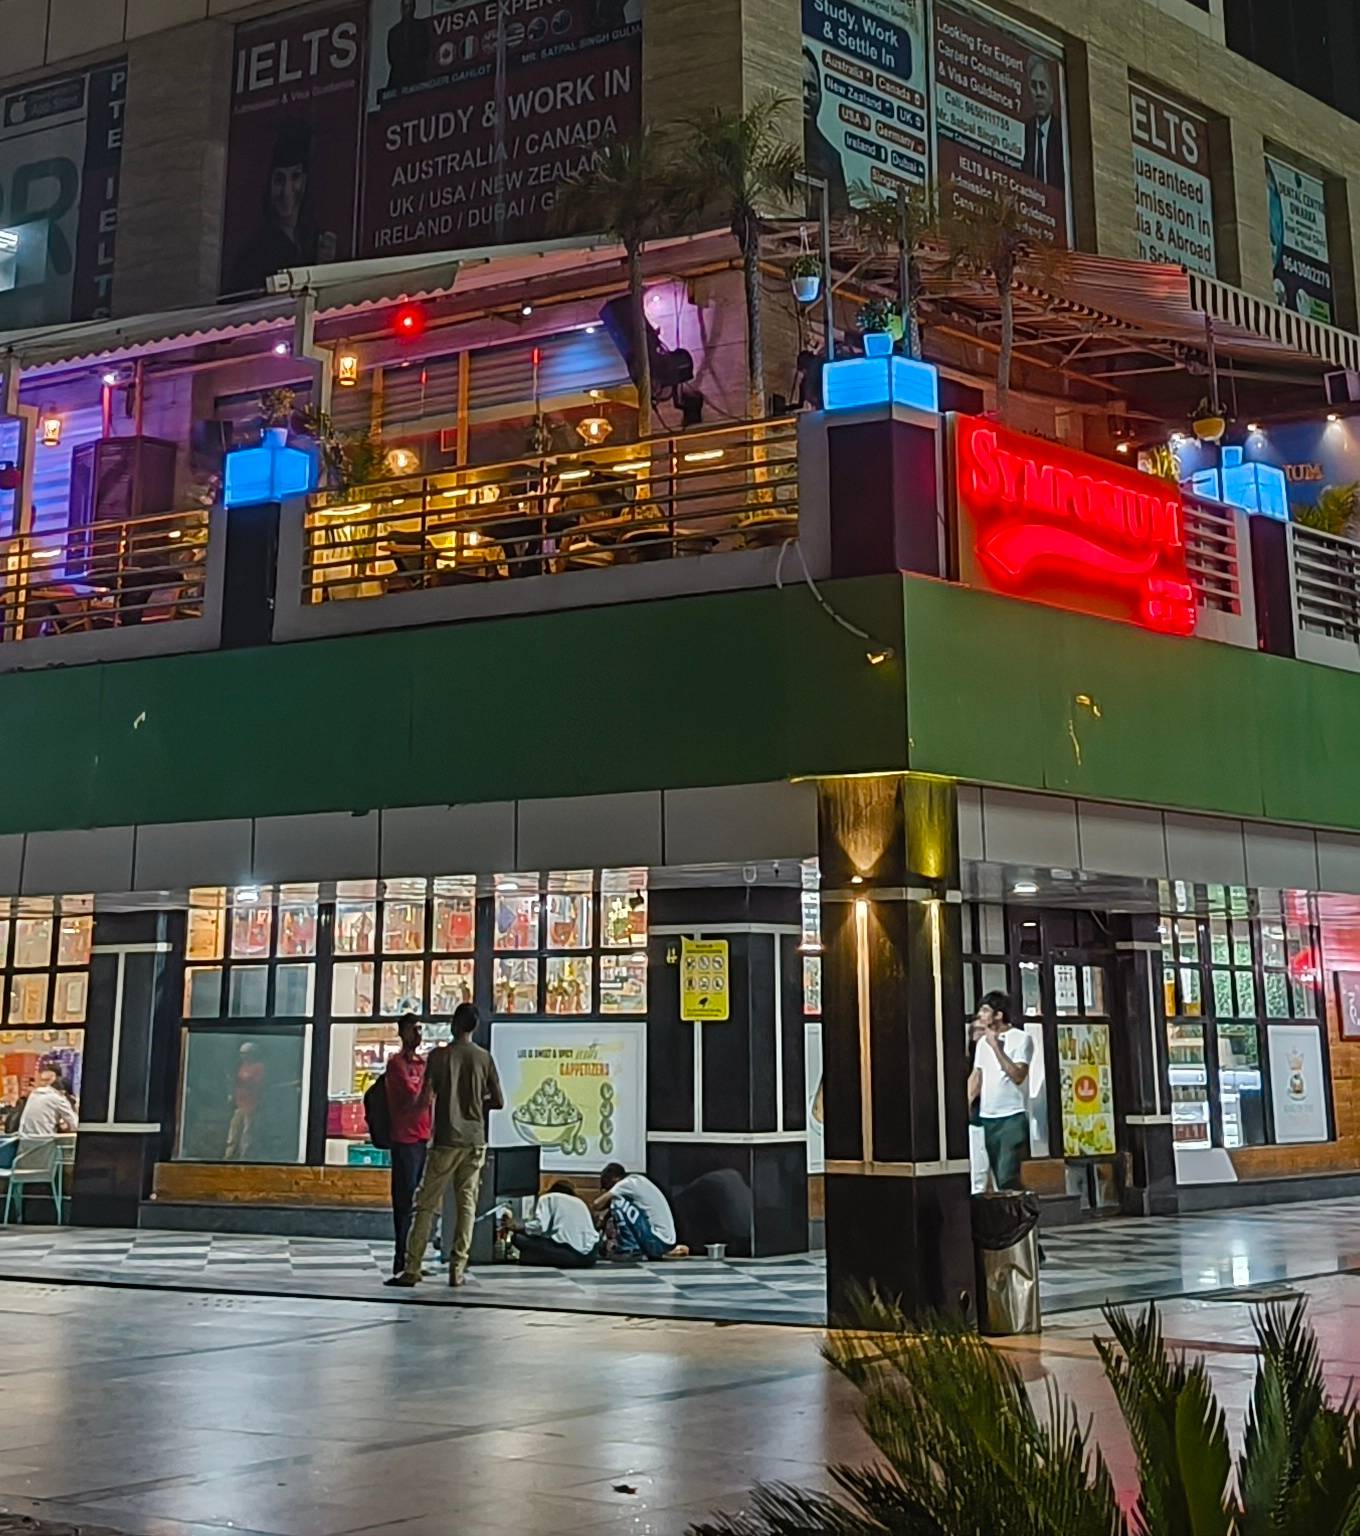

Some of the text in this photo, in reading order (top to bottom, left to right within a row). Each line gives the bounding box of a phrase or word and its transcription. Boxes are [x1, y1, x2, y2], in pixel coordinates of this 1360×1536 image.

[432, 12, 478, 36] VISA
[823, 22, 895, 68] & Settle In
[862, 15, 899, 48] Work
[937, 16, 1024, 73] Looking For Expert
[236, 22, 358, 94] IELTS
[937, 40, 968, 65] Career
[107, 71, 126, 150] PTE
[386, 66, 632, 152] STUDY & WORK IN
[948, 66, 968, 88] Visa
[970, 80, 1013, 111] Guidance
[899, 108, 913, 123] UK
[1131, 94, 1198, 164] ELTS
[391, 142, 507, 187] AUSTRALIA
[525, 115, 617, 155] CANADA
[389, 195, 414, 217] UK
[429, 186, 466, 209] USA
[481, 170, 522, 197] NEW
[527, 155, 600, 186] ZEALAN
[1135, 158, 1203, 204] uaranteed
[374, 215, 452, 249] IRELAND
[468, 198, 525, 228] DUBAI
[1135, 184, 1195, 230] mission
[1198, 211, 1211, 236] in
[1155, 220, 1165, 242] &
[1167, 227, 1212, 263] Abroad
[971, 429, 1183, 547] SYMPOSIUM
